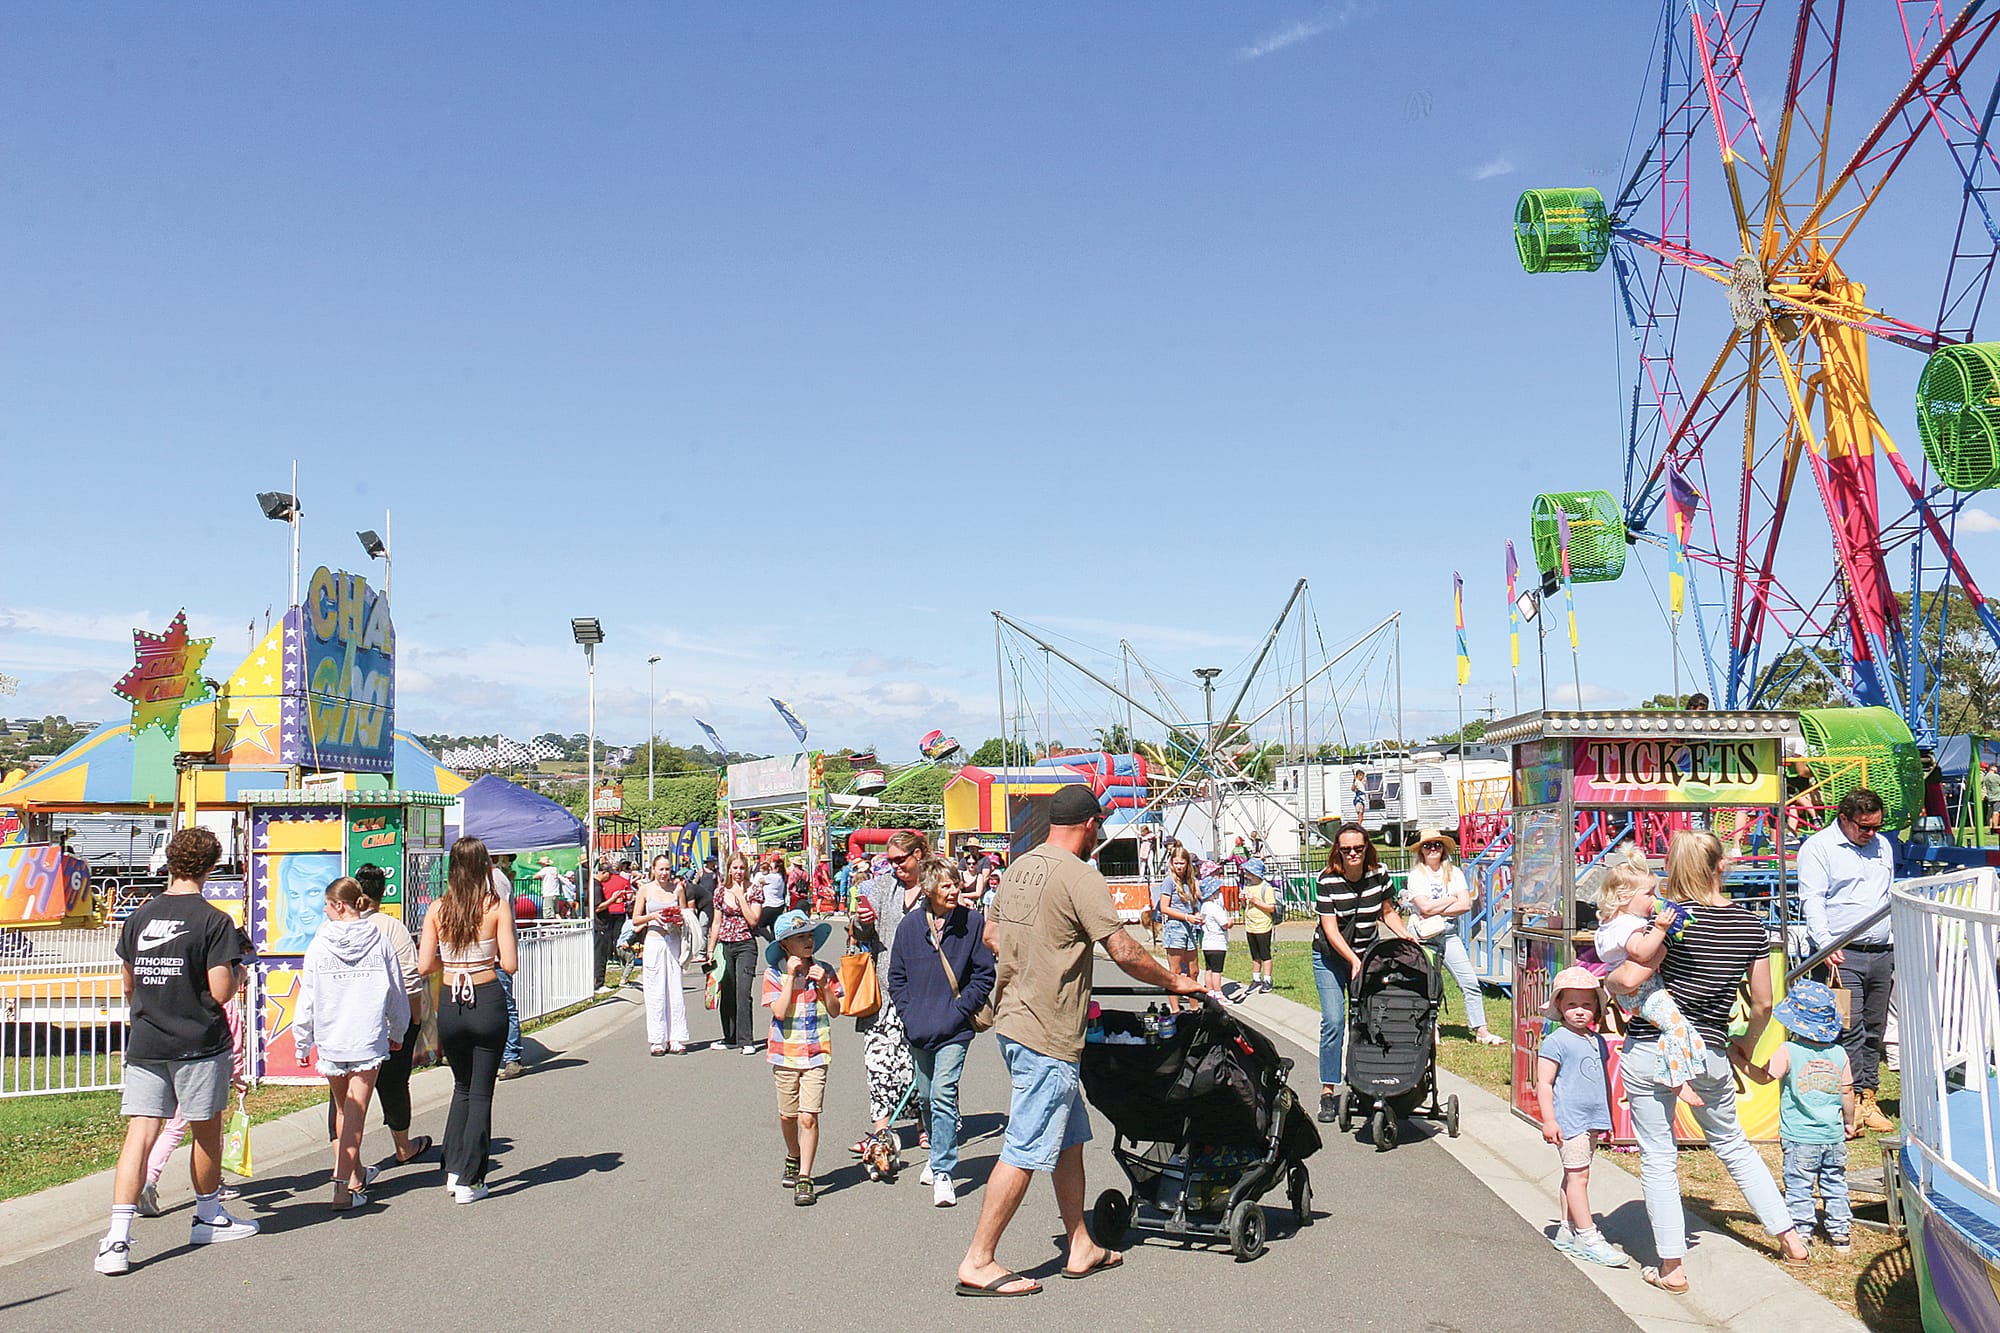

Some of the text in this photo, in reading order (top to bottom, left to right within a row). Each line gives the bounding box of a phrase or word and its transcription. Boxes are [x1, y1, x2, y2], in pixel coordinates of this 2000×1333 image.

[309, 566, 392, 656] CHA
[1588, 741, 1758, 787] TICKETS
[352, 816, 385, 833] CHA
[362, 832, 396, 849] CHA
[644, 835, 669, 847] TICKETS
[71, 871, 82, 891] 6
[143, 919, 182, 938] NIKE
[134, 956, 185, 967] UTHORIZED
[319, 954, 385, 971] JAAD
[133, 966, 183, 976] ERSONNEL
[142, 976, 168, 986] ONLY
